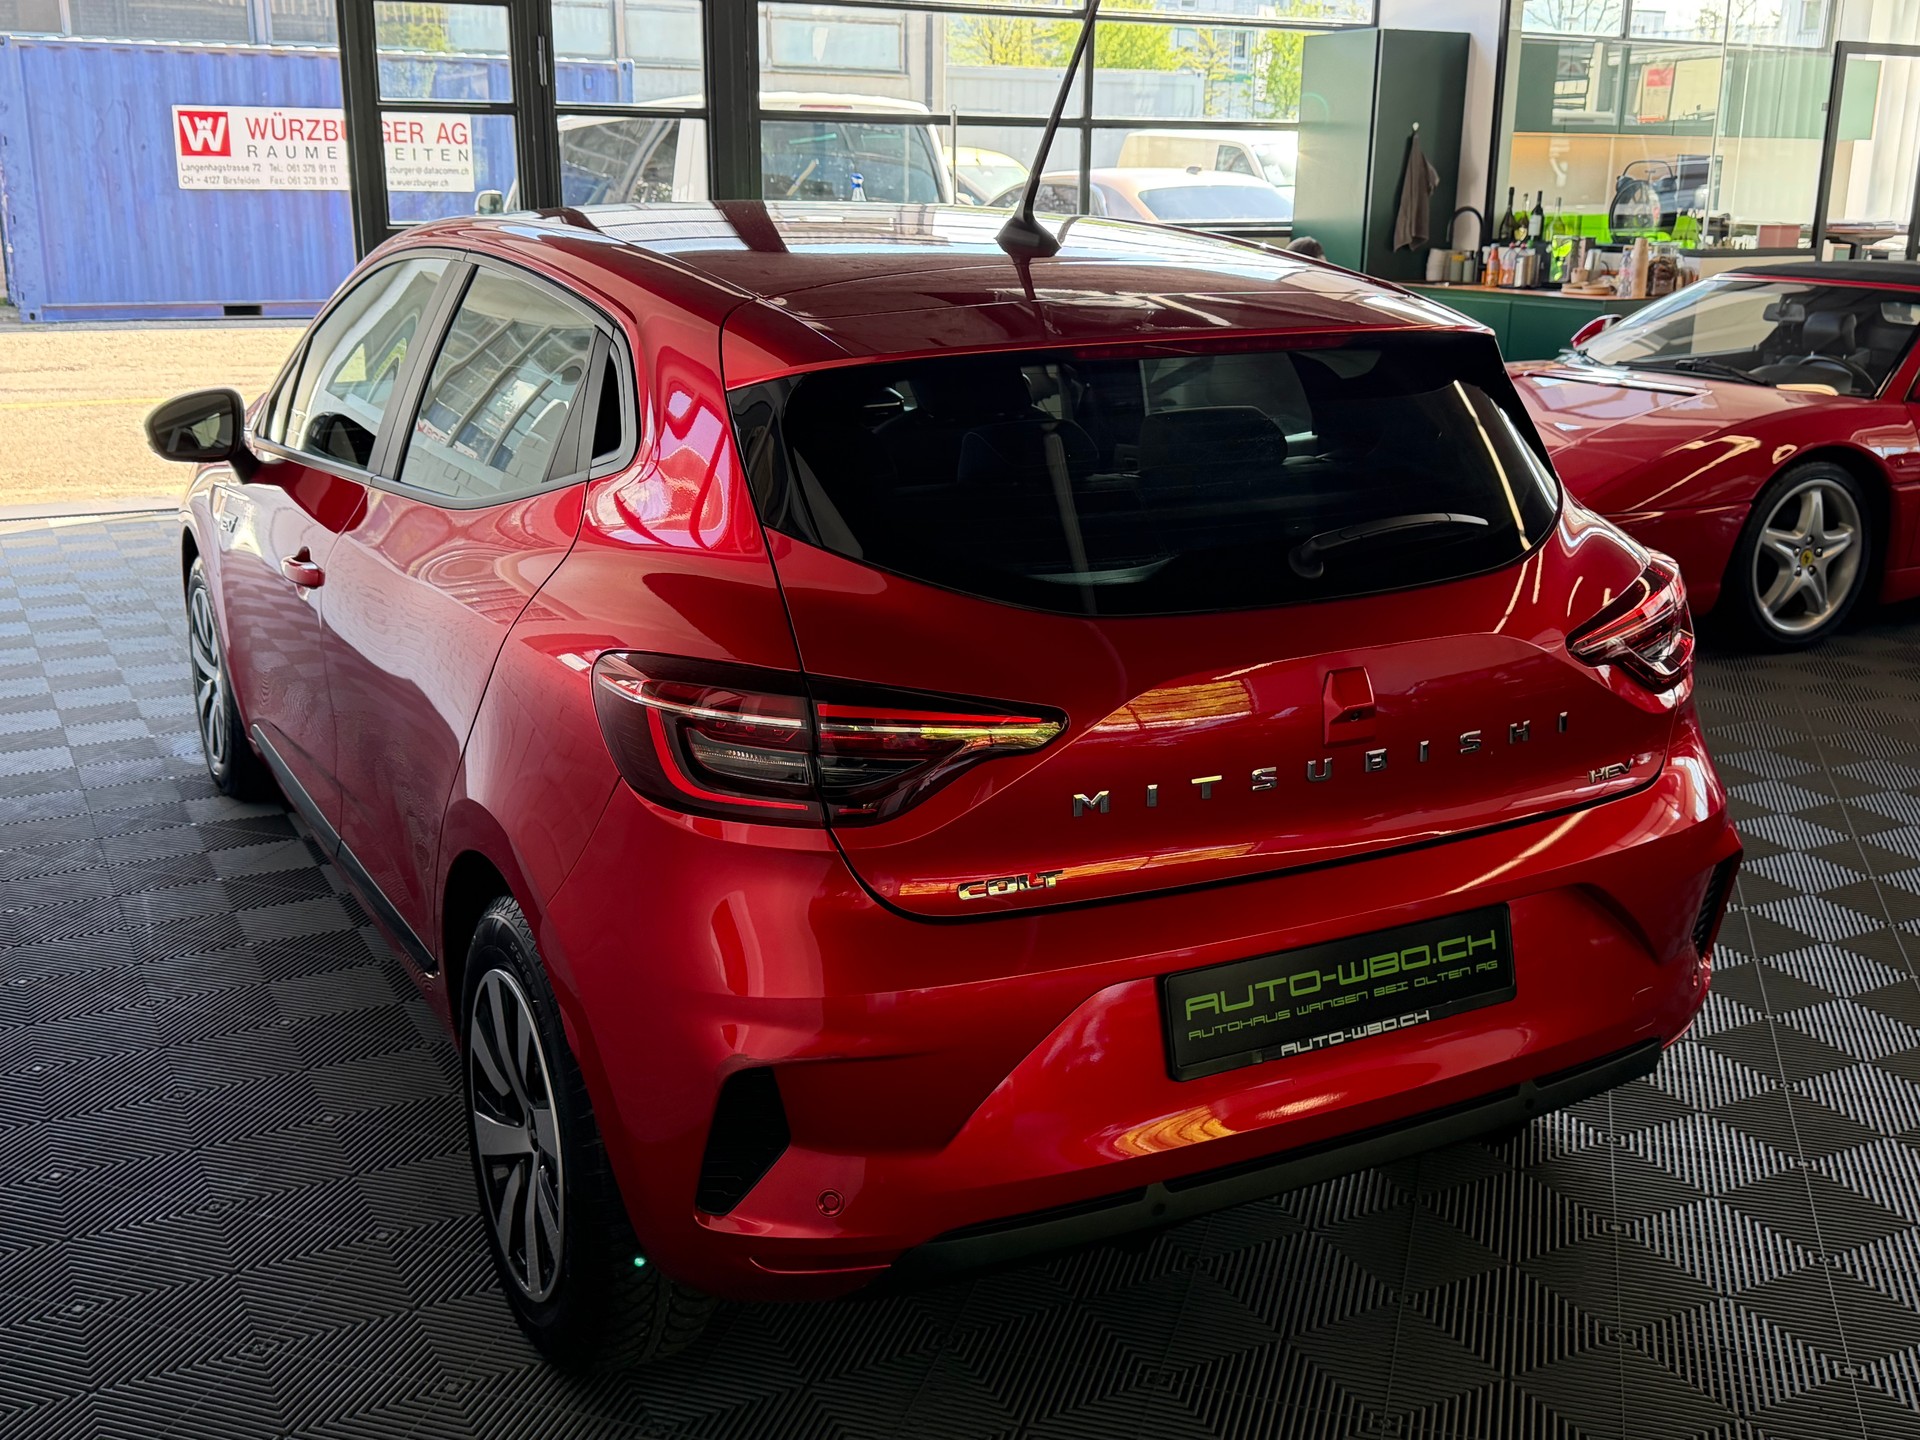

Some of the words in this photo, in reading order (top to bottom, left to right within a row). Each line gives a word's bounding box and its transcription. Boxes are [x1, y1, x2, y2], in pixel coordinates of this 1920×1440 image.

[245, 111, 425, 144] WÜRZBGER
[436, 122, 468, 145] AG
[180, 162, 250, 173] Langenhagstrasse
[252, 163, 262, 172] 72
[182, 175, 194, 184] CH
[203, 175, 220, 184] 4127
[286, 163, 301, 173] 061
[318, 164, 328, 173] 91
[287, 175, 301, 185] 061
[1072, 710, 1569, 818] MITSUBISHI
[1587, 757, 1635, 784] HEV
[957, 869, 1064, 900] COLT
[1188, 1009, 1291, 1041] AUTOHAUS
[1296, 991, 1369, 1016] WANGEN
[1373, 981, 1409, 998] BEI
[1413, 967, 1471, 988] OLTEN
[1475, 959, 1499, 975] AG
